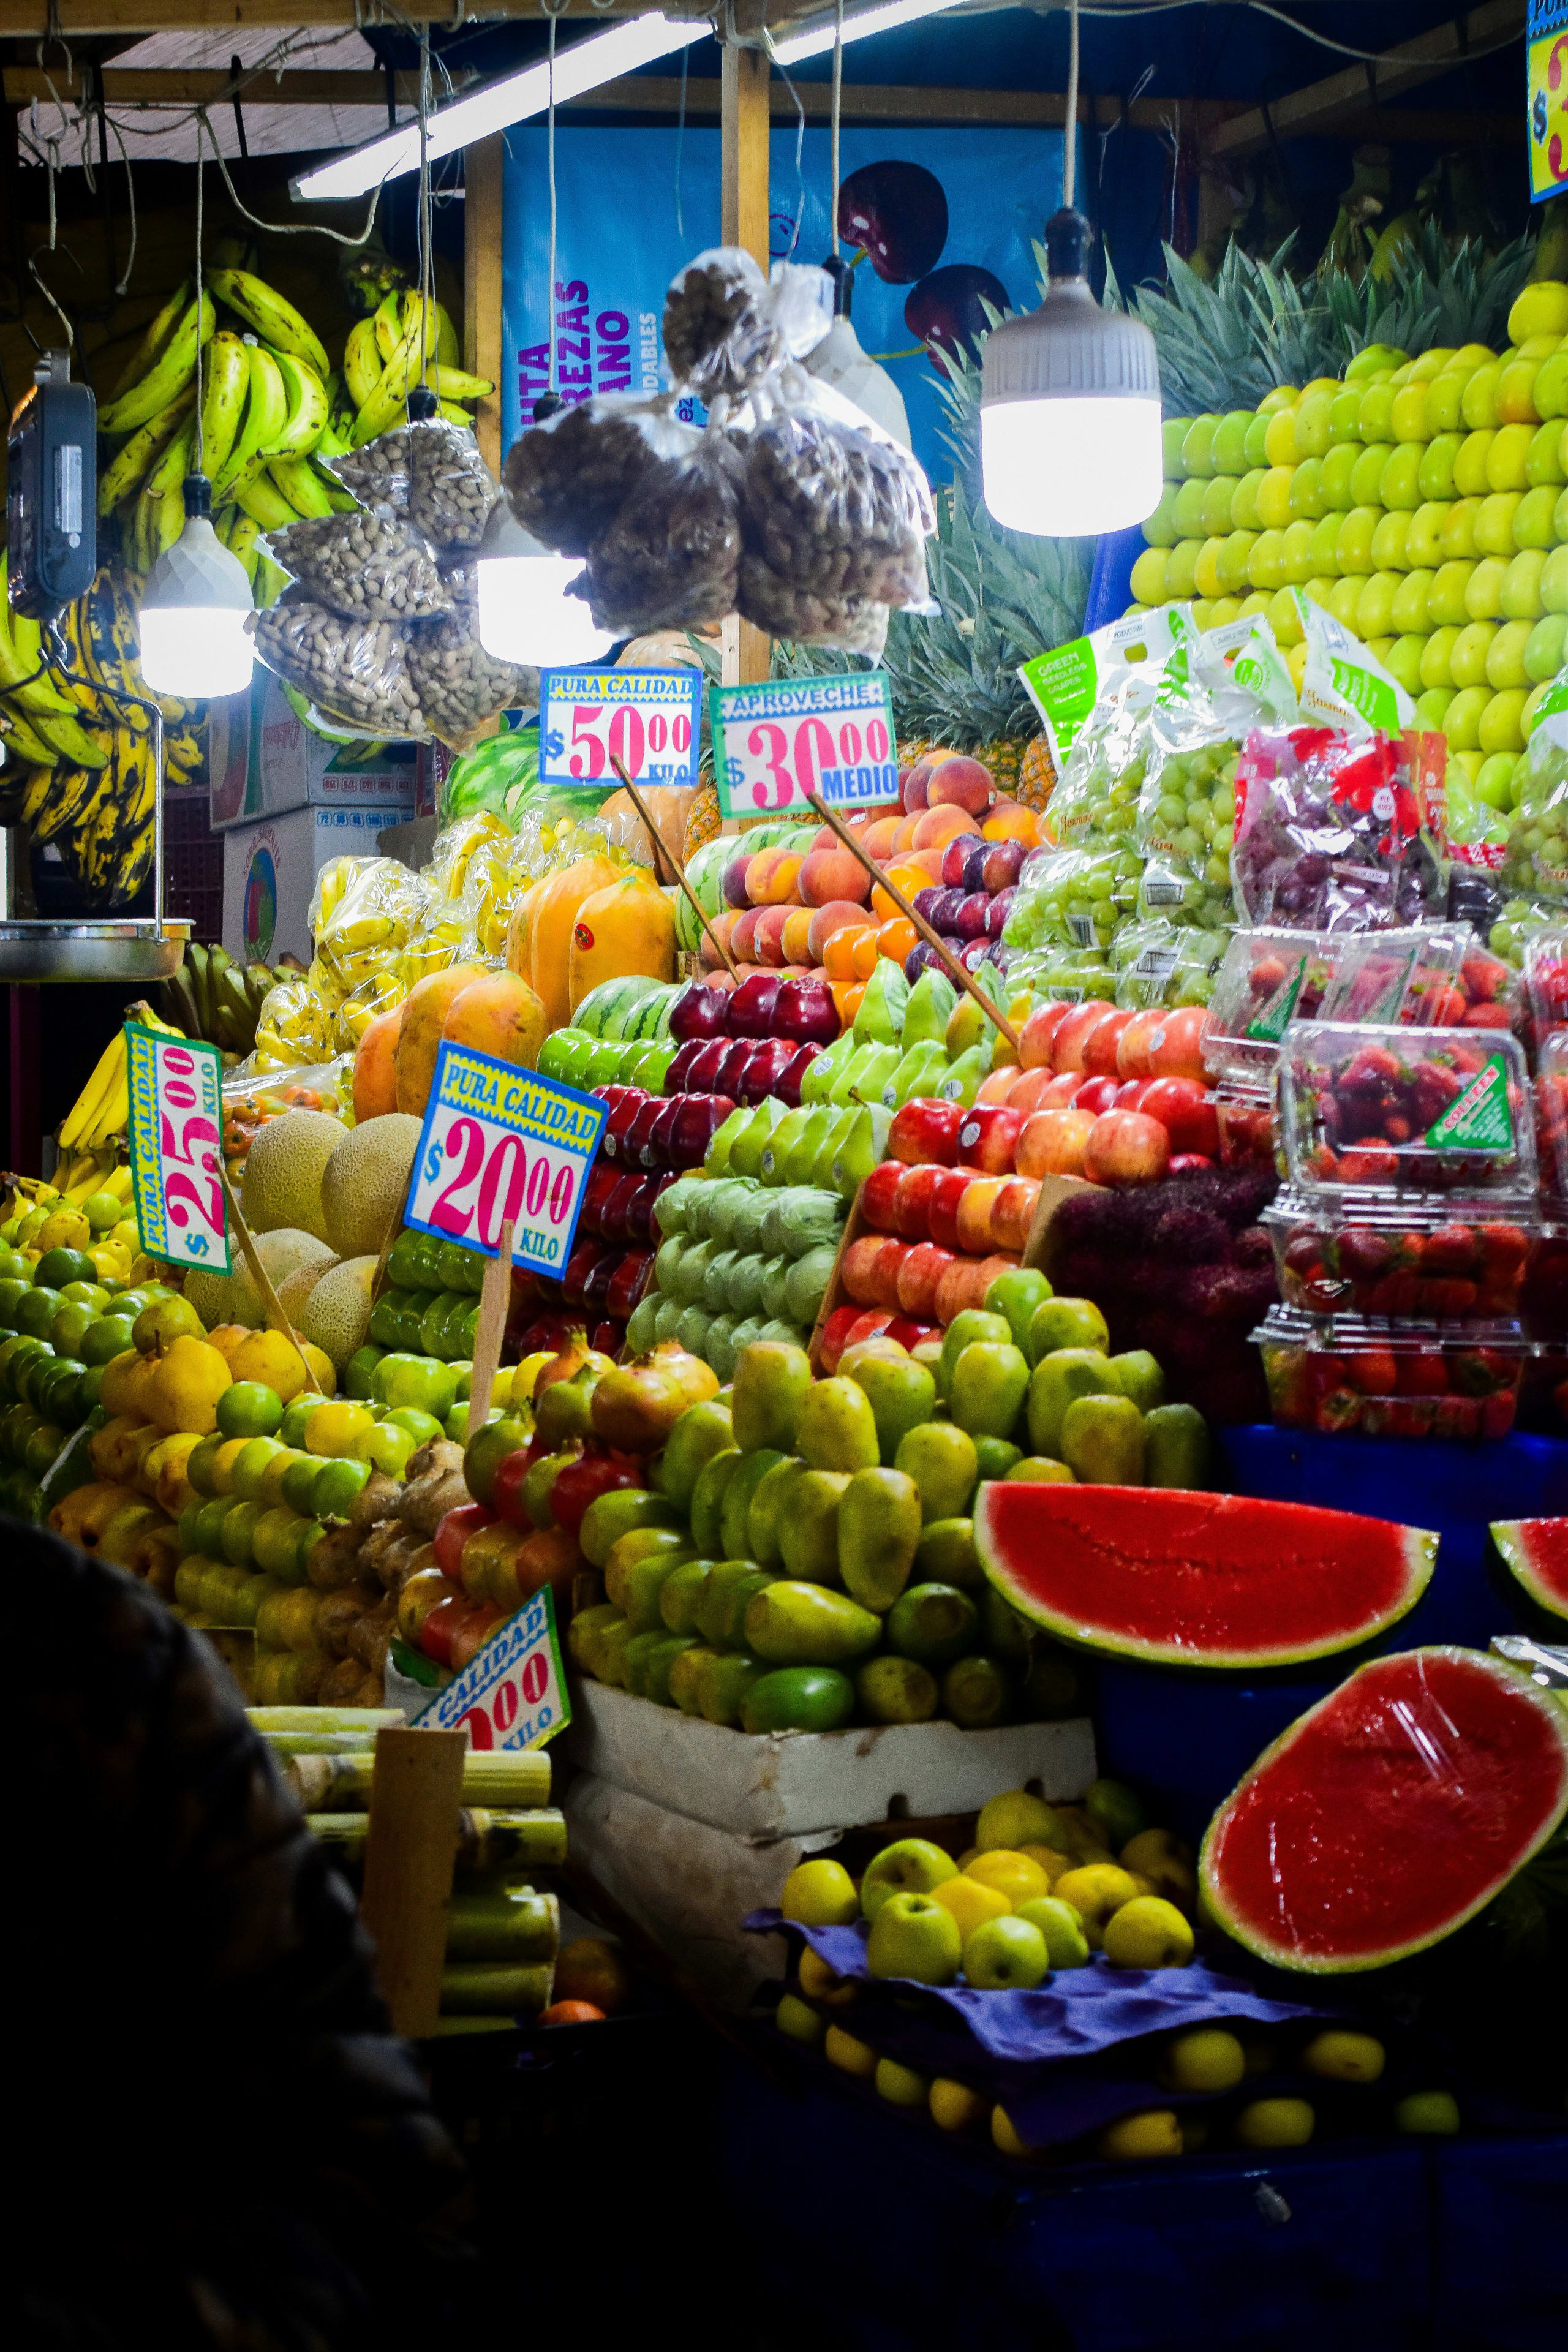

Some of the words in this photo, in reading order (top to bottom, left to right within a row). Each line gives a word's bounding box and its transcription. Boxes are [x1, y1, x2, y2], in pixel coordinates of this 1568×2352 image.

[555, 280, 592, 407] REZAS
[640, 312, 659, 397] DABLES
[551, 678, 600, 694] PURA
[607, 678, 694, 695] CALIDAD
[1038, 651, 1079, 677] GREEN
[734, 684, 869, 712] APROVECHE
[648, 764, 688, 780] KILO
[821, 764, 898, 801] MEDIO
[136, 1036, 157, 1162] CALIDAD
[201, 1063, 217, 1117] KILO
[443, 1063, 499, 1105] PURA
[503, 1087, 598, 1139] CALIDAD
[146, 1172, 163, 1250] PURA
[519, 1227, 559, 1261] KILO
[437, 1606, 543, 1722] CALIDAD
[502, 1706, 552, 1751] KILO
